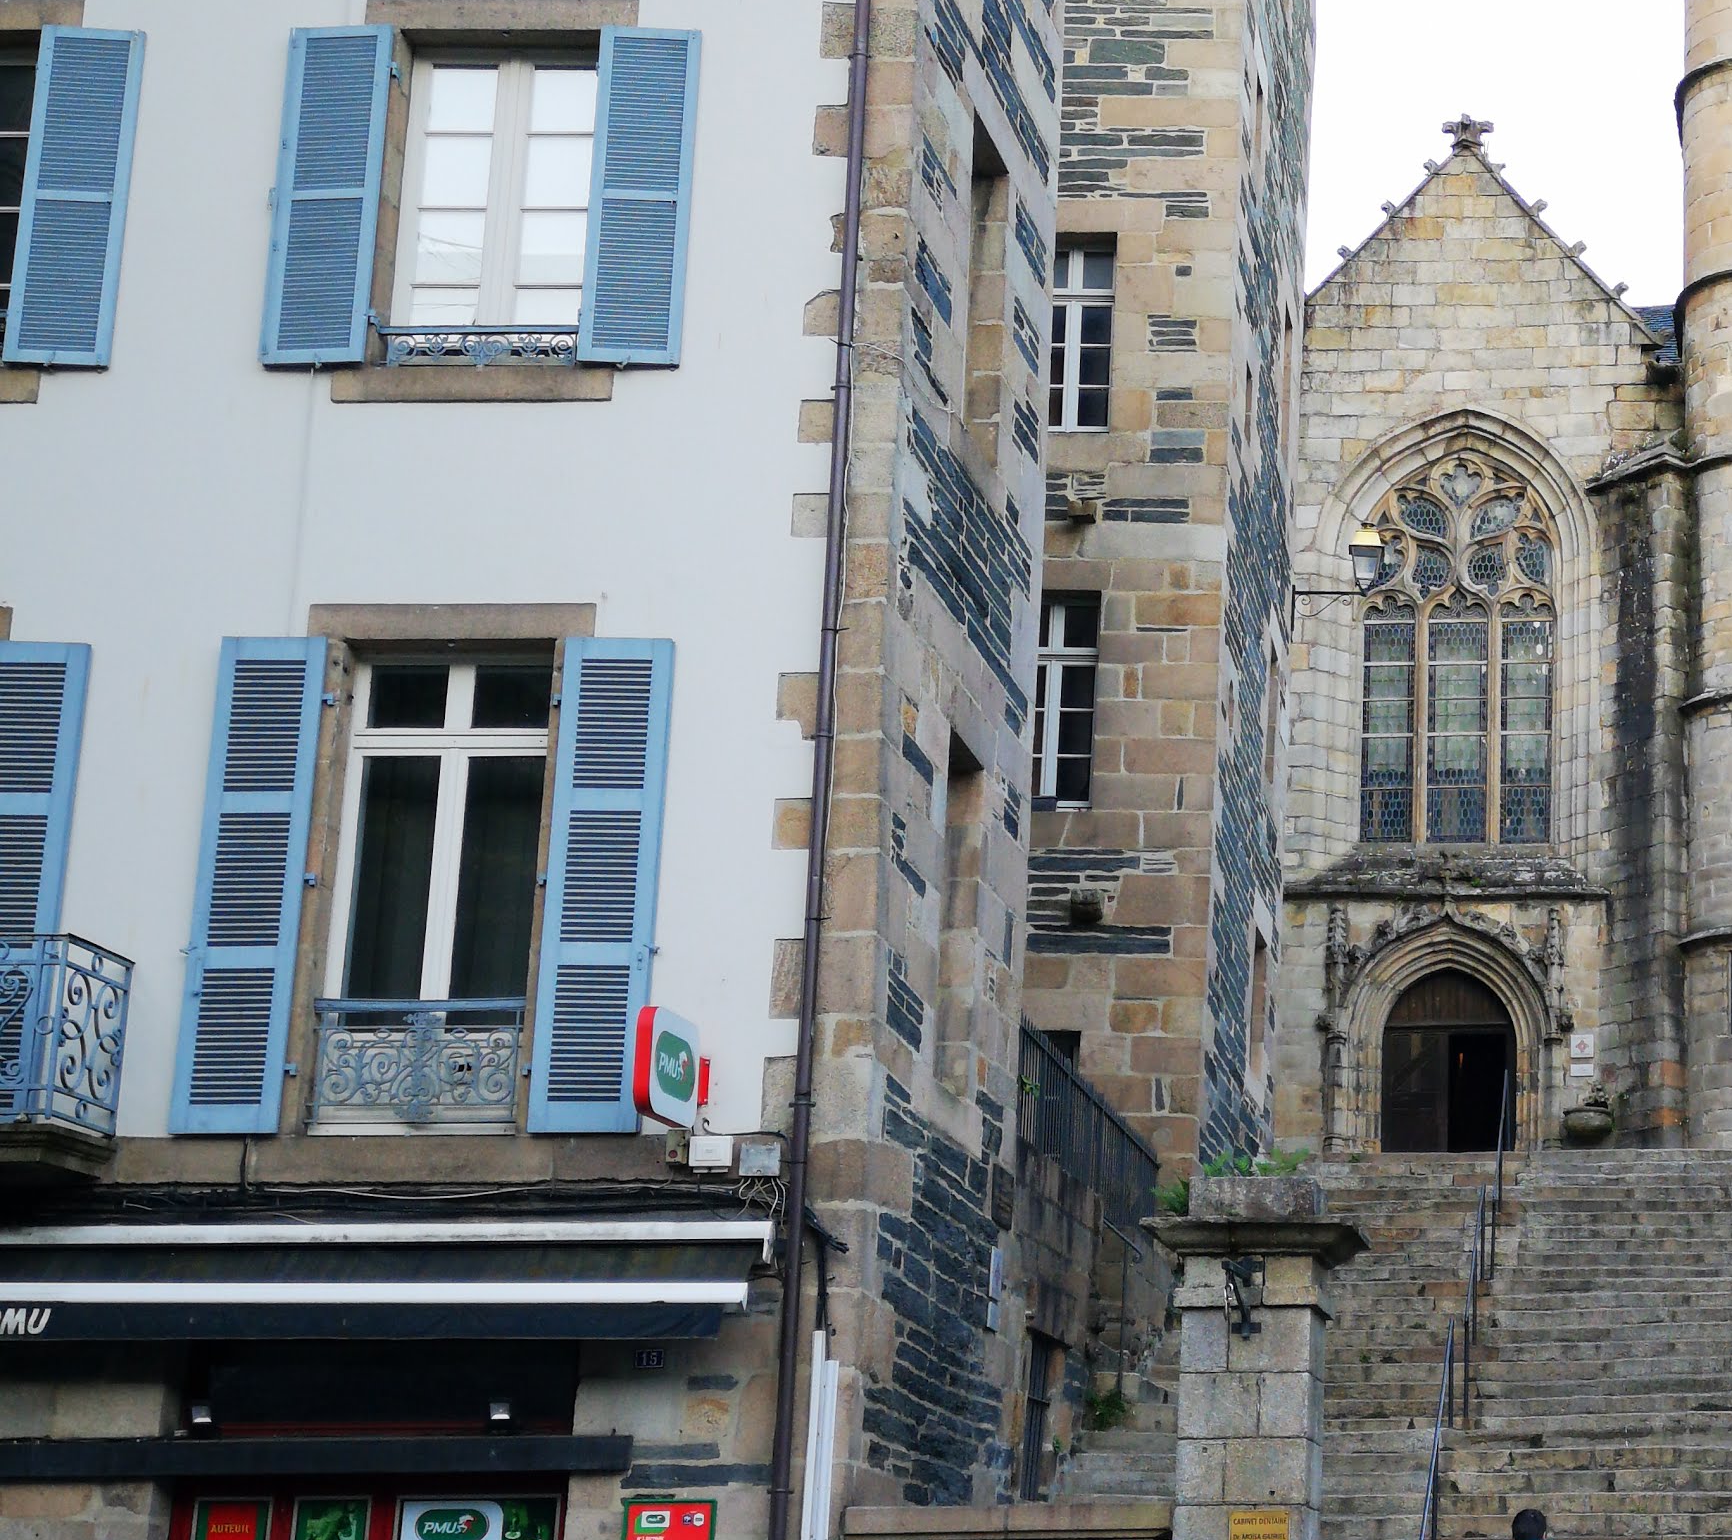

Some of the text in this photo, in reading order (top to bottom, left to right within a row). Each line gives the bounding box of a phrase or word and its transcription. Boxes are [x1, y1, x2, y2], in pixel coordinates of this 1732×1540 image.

[659, 1051, 679, 1079] PMU
[0, 1308, 51, 1334] MU
[642, 1352, 657, 1365] 15
[423, 1521, 457, 1534] PMU
[1259, 1517, 1287, 1525] DENTAIRE
[211, 1524, 249, 1533] AUTEUIL
